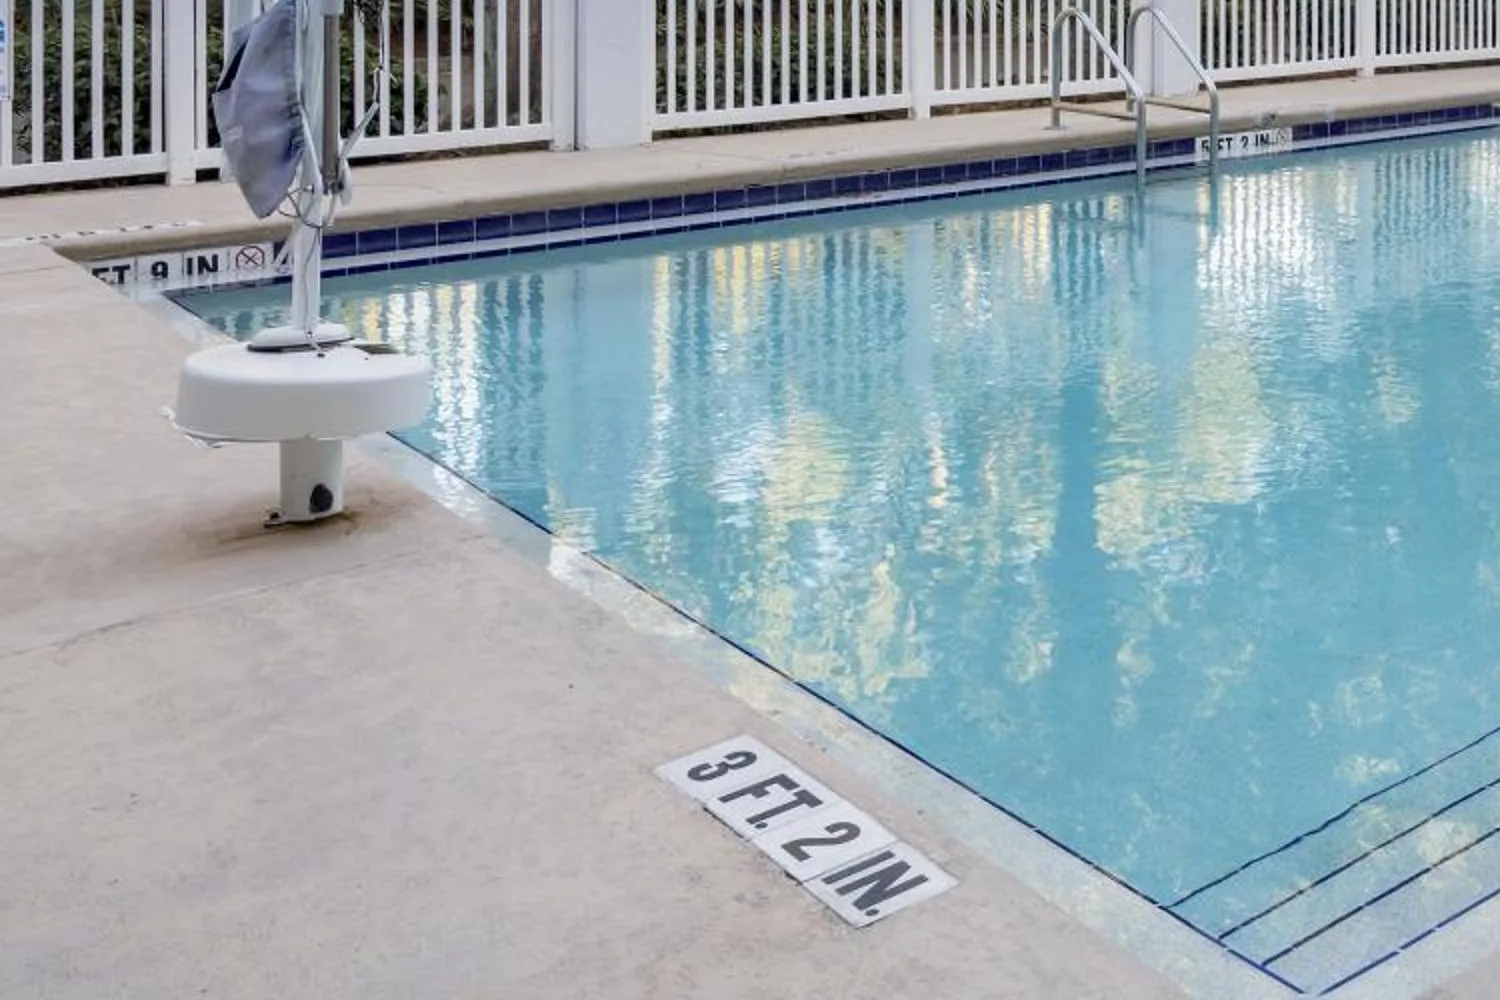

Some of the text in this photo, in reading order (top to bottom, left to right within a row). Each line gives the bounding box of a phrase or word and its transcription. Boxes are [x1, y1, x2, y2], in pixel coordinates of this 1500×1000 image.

[1217, 137, 1233, 151] FT
[186, 254, 219, 277] IN
[687, 750, 930, 918] 3 FT. 2 IN.
